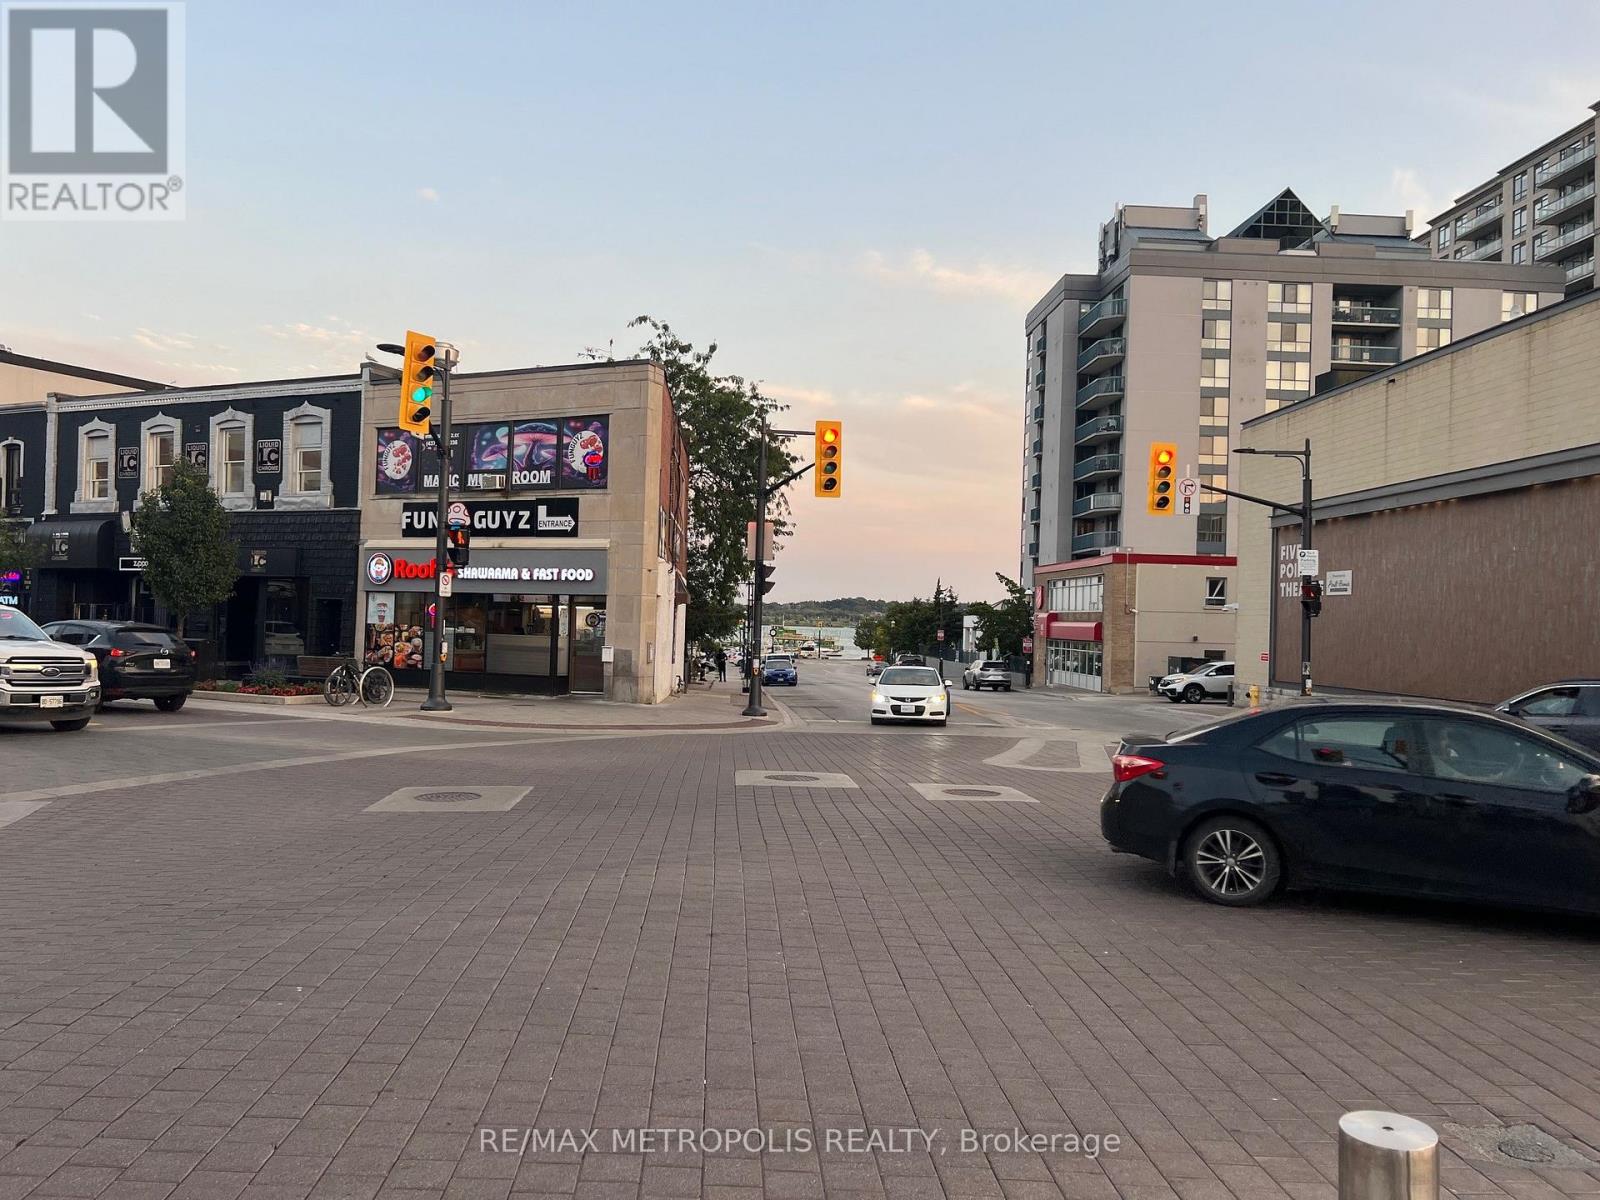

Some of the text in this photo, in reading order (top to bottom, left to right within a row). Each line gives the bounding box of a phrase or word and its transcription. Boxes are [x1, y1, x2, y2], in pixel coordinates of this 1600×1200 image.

[512, 469, 551, 485] ROOM
[473, 510, 530, 530] GUYZ
[538, 520, 573, 528] ENTRANCE
[521, 568, 530, 580] &
[533, 568, 559, 580] FAST
[561, 568, 594, 581] FOOD
[0, 596, 18, 605] ATM
